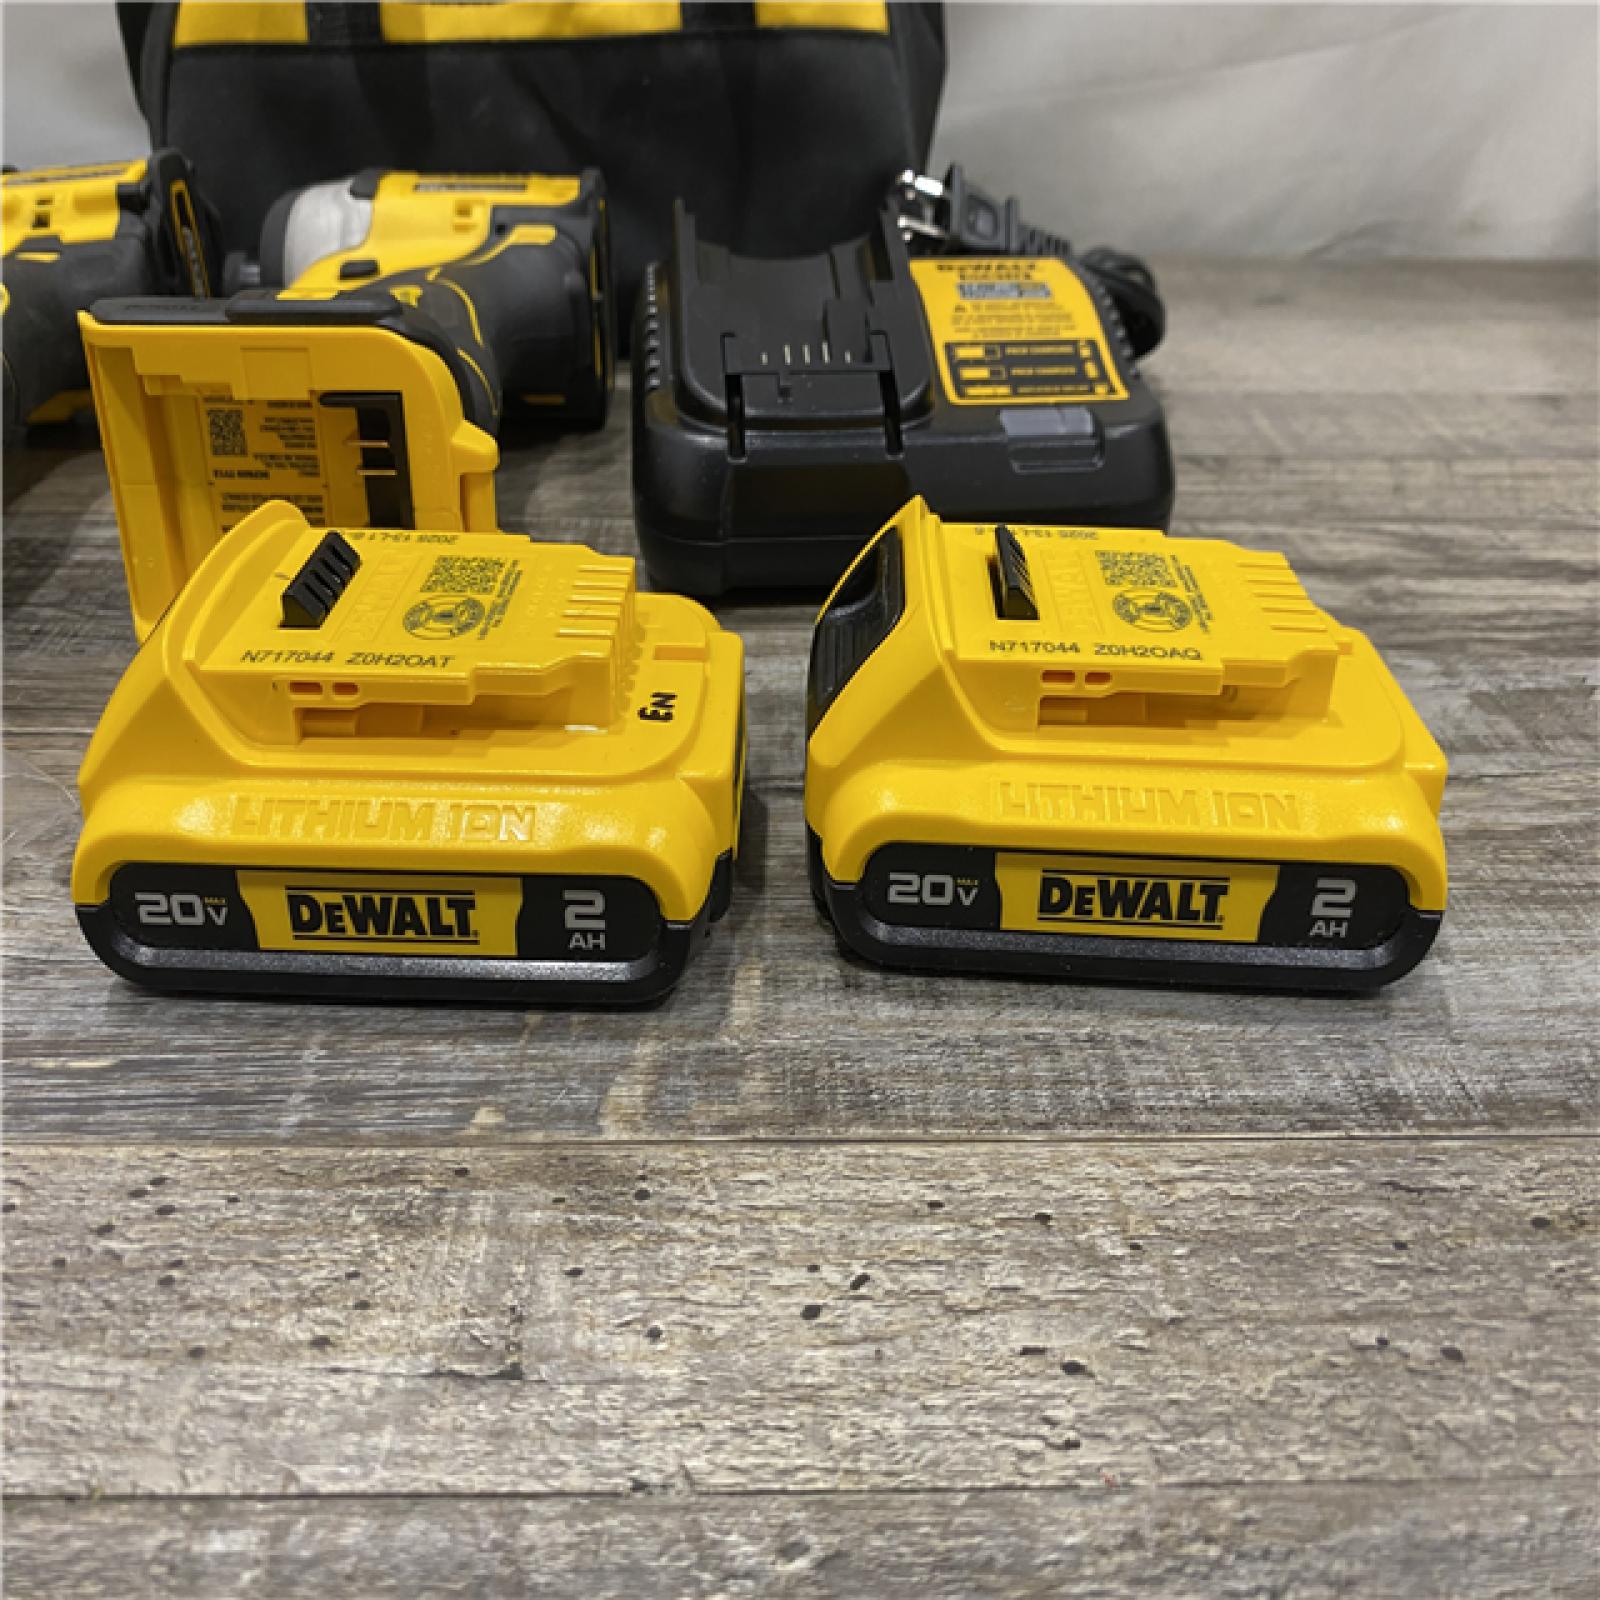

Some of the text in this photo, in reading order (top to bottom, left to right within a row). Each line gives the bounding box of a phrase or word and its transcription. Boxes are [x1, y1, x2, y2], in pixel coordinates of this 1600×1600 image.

[240, 649, 335, 664] N717044
[989, 639, 1081, 654] N717044
[232, 796, 536, 842] LITHIUM ION
[998, 781, 1300, 832] LITHIUM ION
[286, 892, 477, 939] DEWALT
[562, 889, 606, 930] 2
[1037, 875, 1230, 924] DEWALT
[1310, 876, 1357, 919] 2
[568, 931, 606, 951] AH
[1308, 919, 1350, 939] AH
